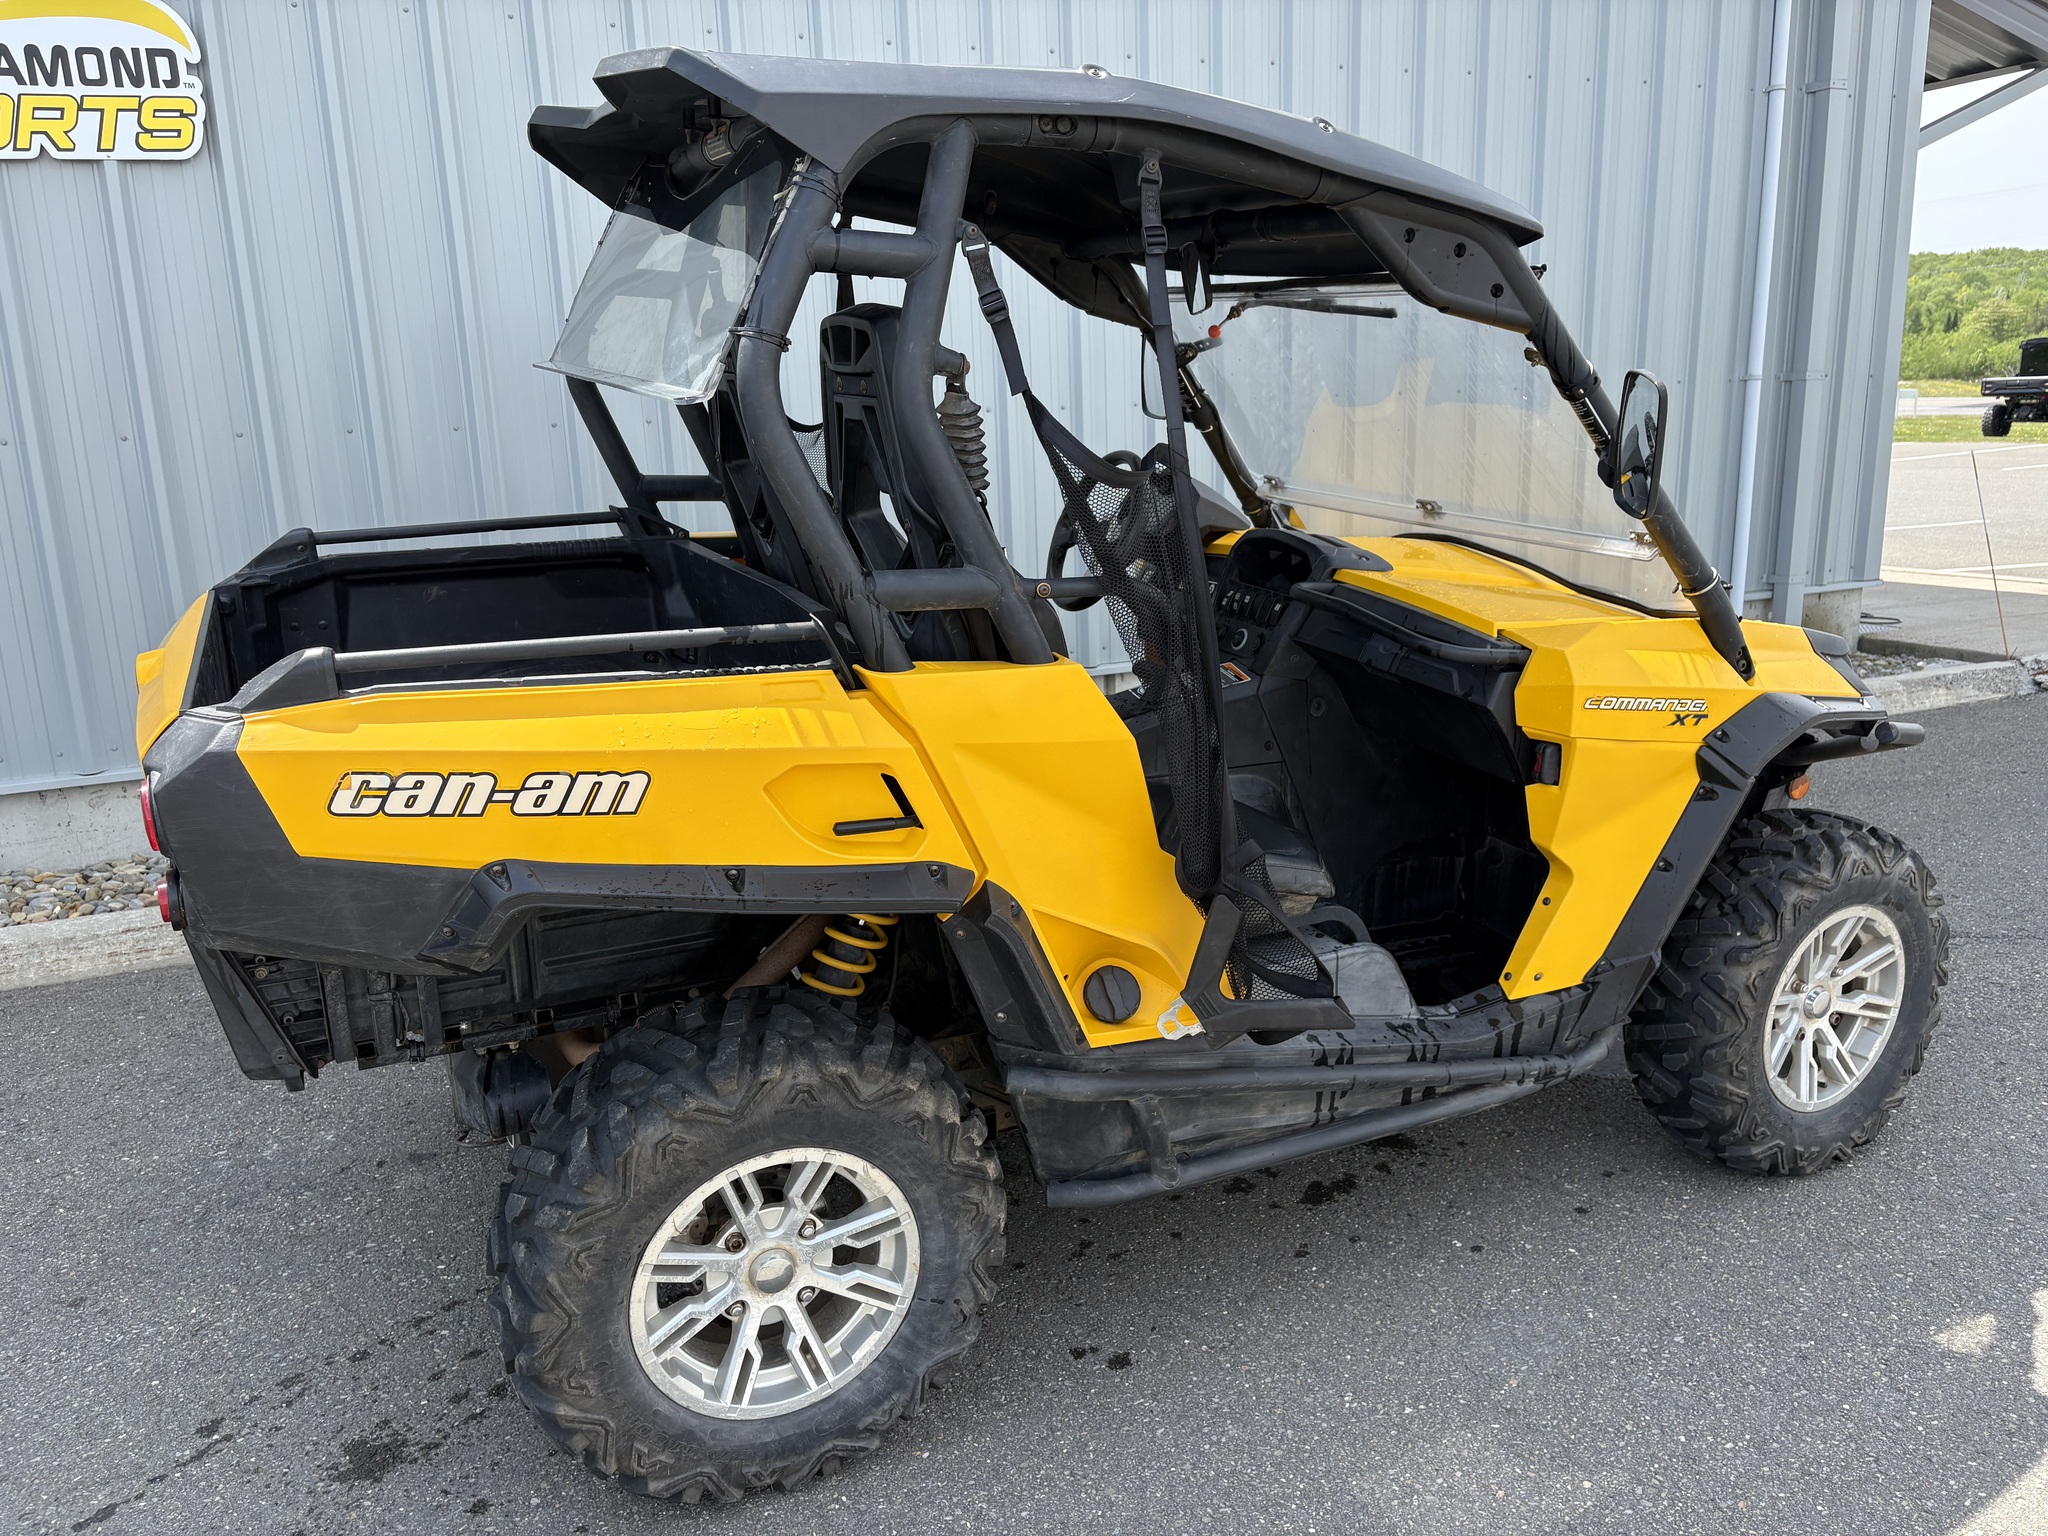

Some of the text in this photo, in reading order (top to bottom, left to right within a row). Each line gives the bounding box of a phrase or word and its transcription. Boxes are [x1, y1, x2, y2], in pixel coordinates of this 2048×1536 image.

[0, 92, 197, 152] RTS
[1666, 713, 1709, 726] XT
[327, 771, 651, 817] can-am
